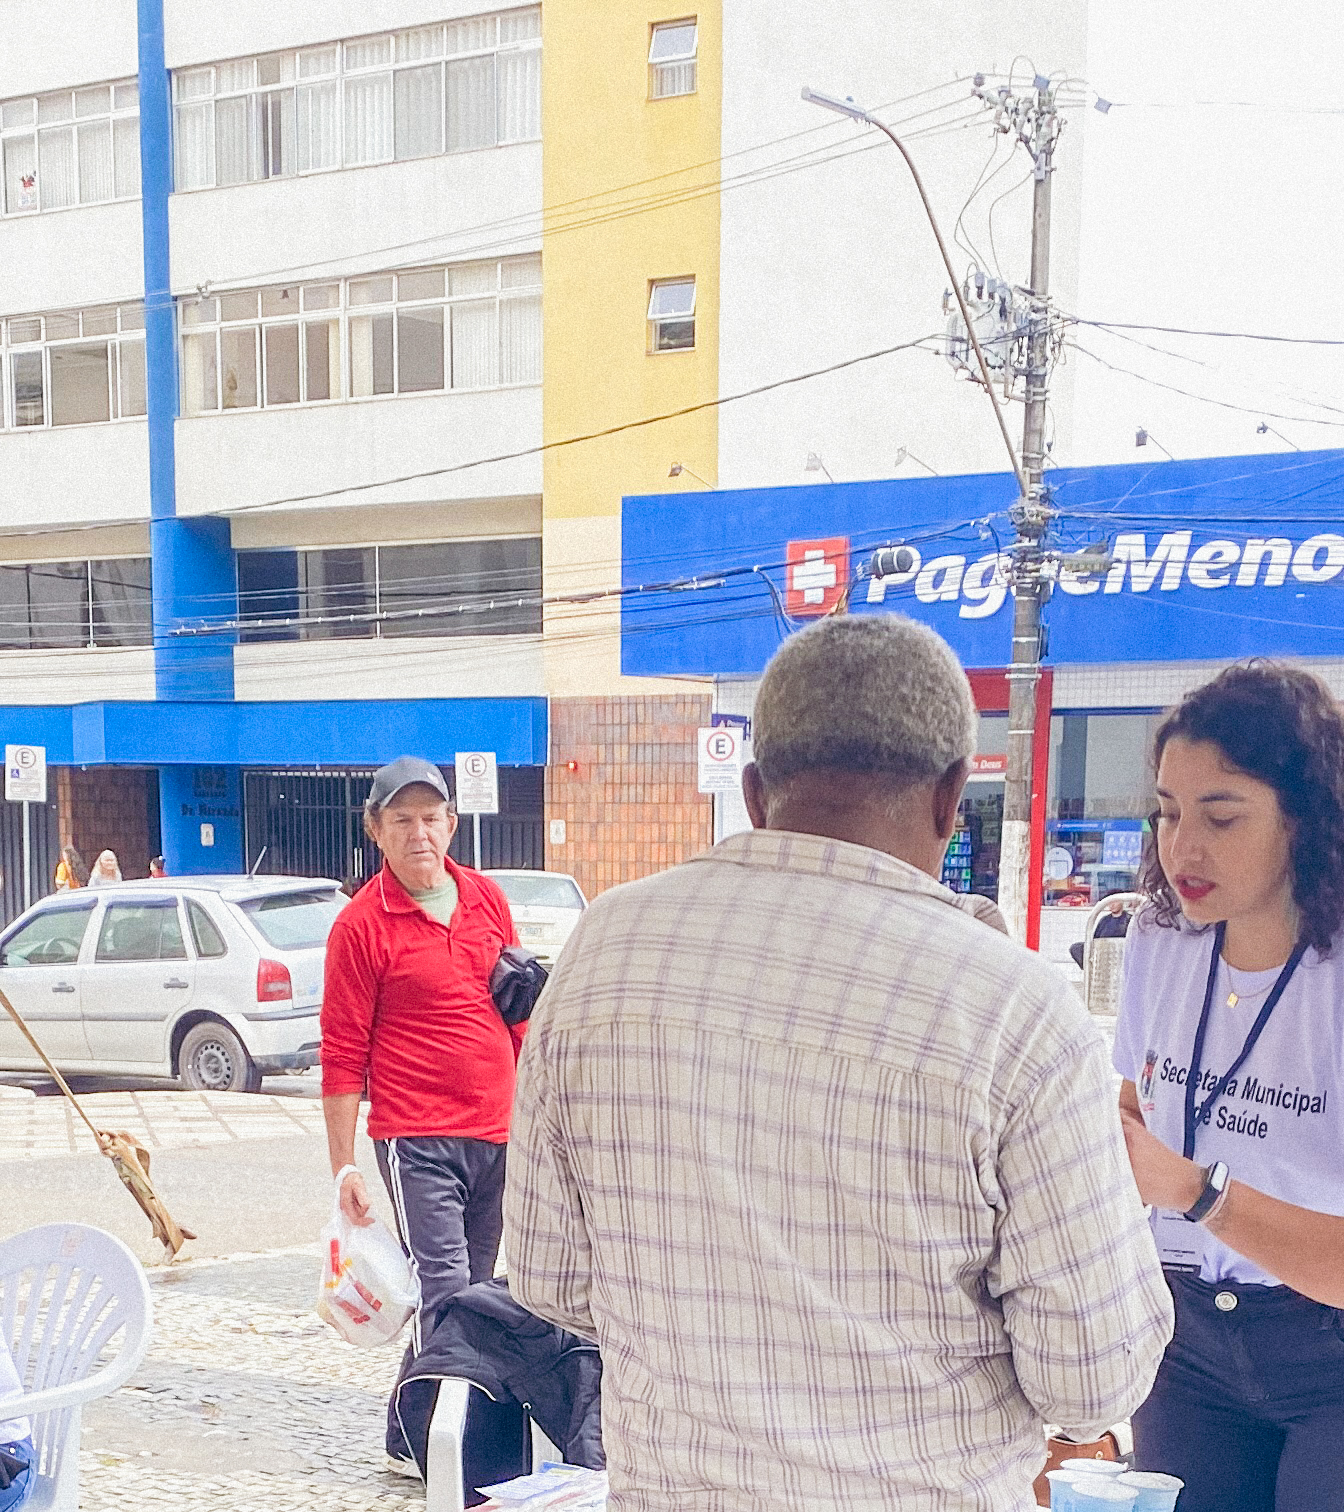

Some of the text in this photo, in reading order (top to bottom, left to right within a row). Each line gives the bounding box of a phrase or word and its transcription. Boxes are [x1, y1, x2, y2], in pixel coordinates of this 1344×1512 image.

[716, 738, 726, 755] E
[20, 751, 30, 765] E
[471, 758, 482, 774] E
[1241, 1076, 1328, 1117] Municipal
[1215, 1105, 1269, 1140] Saúde
